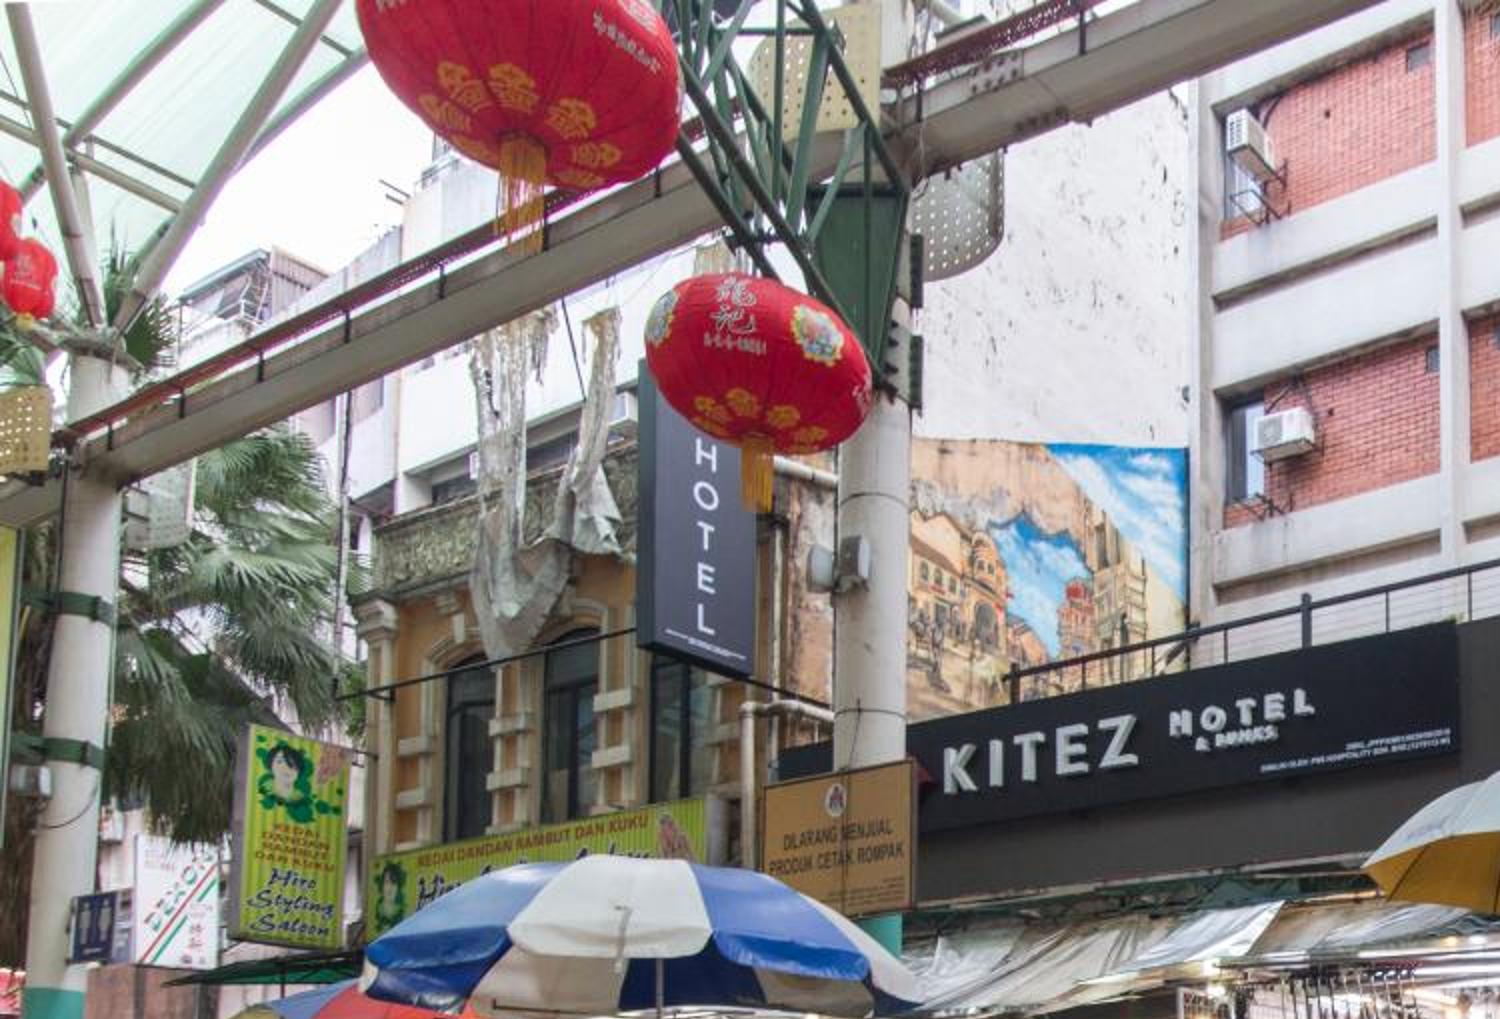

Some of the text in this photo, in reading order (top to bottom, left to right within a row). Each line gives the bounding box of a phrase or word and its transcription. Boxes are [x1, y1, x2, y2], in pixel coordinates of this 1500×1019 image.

[692, 437, 720, 636] HOTEL
[1169, 688, 1315, 738] HOTEL
[943, 712, 1139, 795] KITEZ
[417, 851, 458, 868] KEDAI
[516, 829, 571, 851] RAMBUT
[575, 823, 605, 839] DAN
[608, 814, 649, 832] KUKU
[768, 841, 904, 875] PRODUK CETAK ROMPAK
[784, 824, 837, 851] DILARANG
[246, 888, 335, 919] Styling
[249, 913, 330, 937] Saloon
